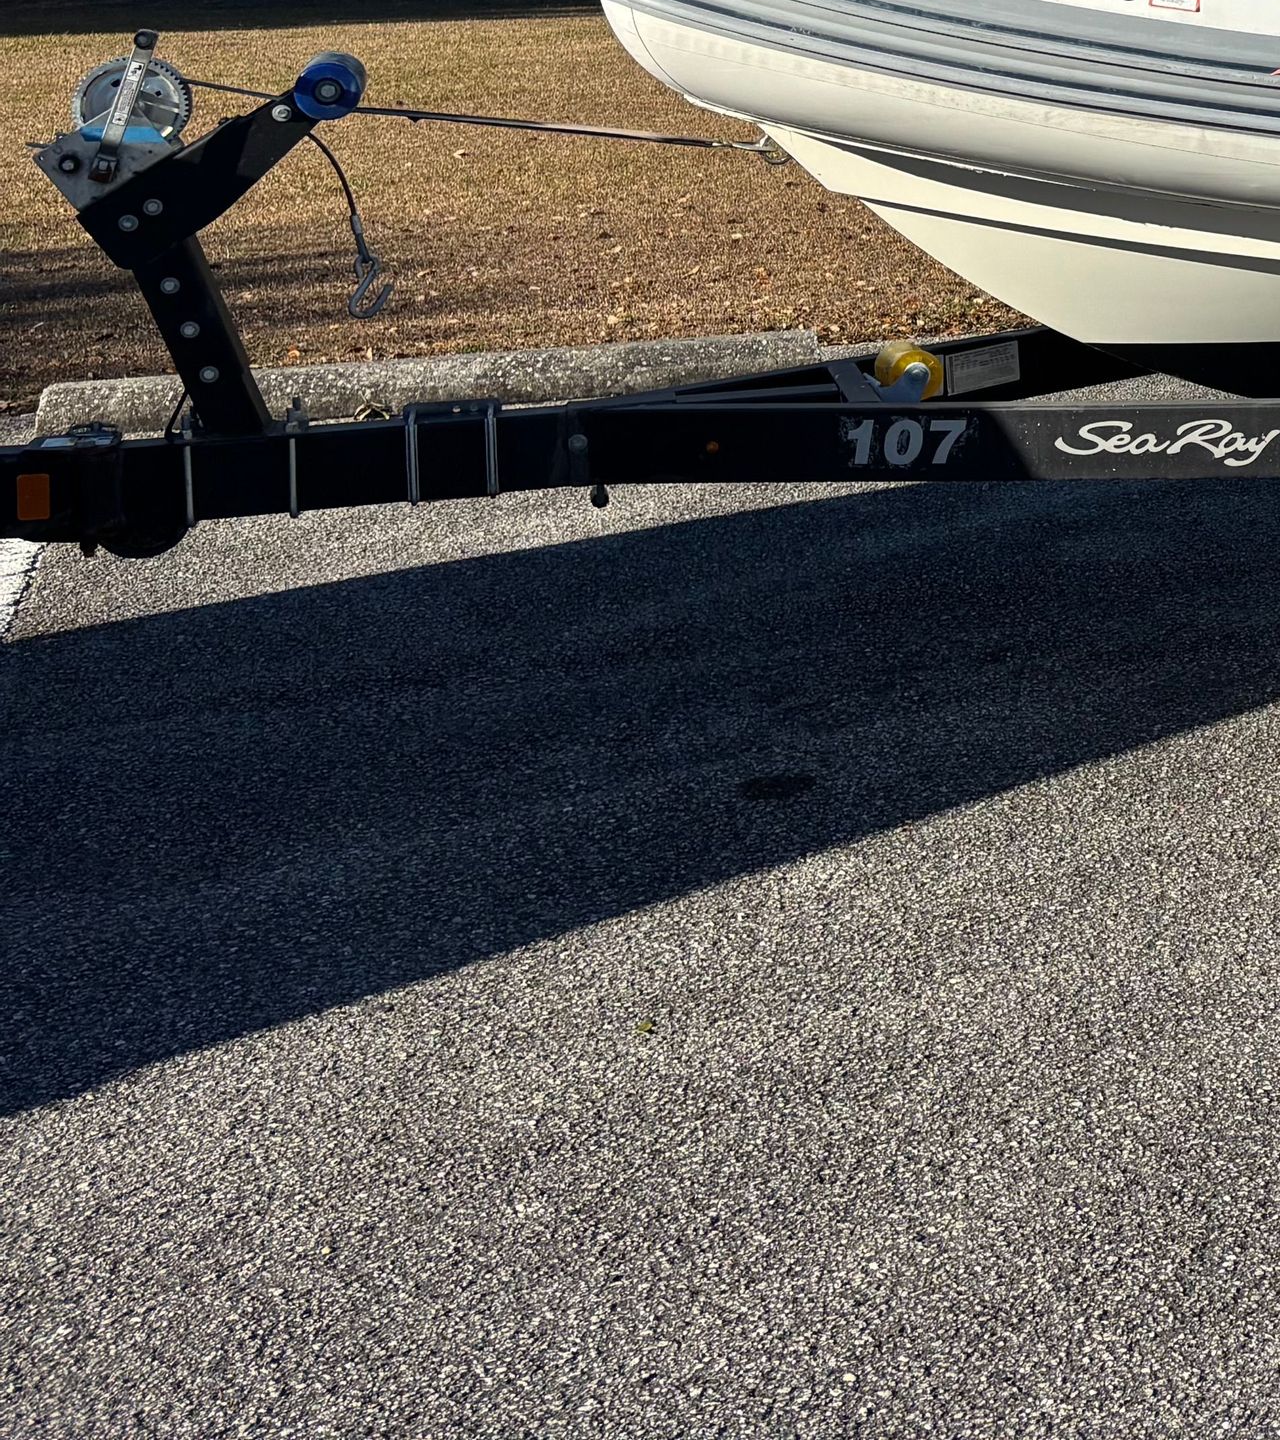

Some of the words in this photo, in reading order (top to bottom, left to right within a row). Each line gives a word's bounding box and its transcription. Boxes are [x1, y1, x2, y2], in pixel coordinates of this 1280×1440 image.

[847, 419, 967, 465] 107
[1054, 419, 1172, 457] Sea
[1166, 418, 1280, 468] Ray
